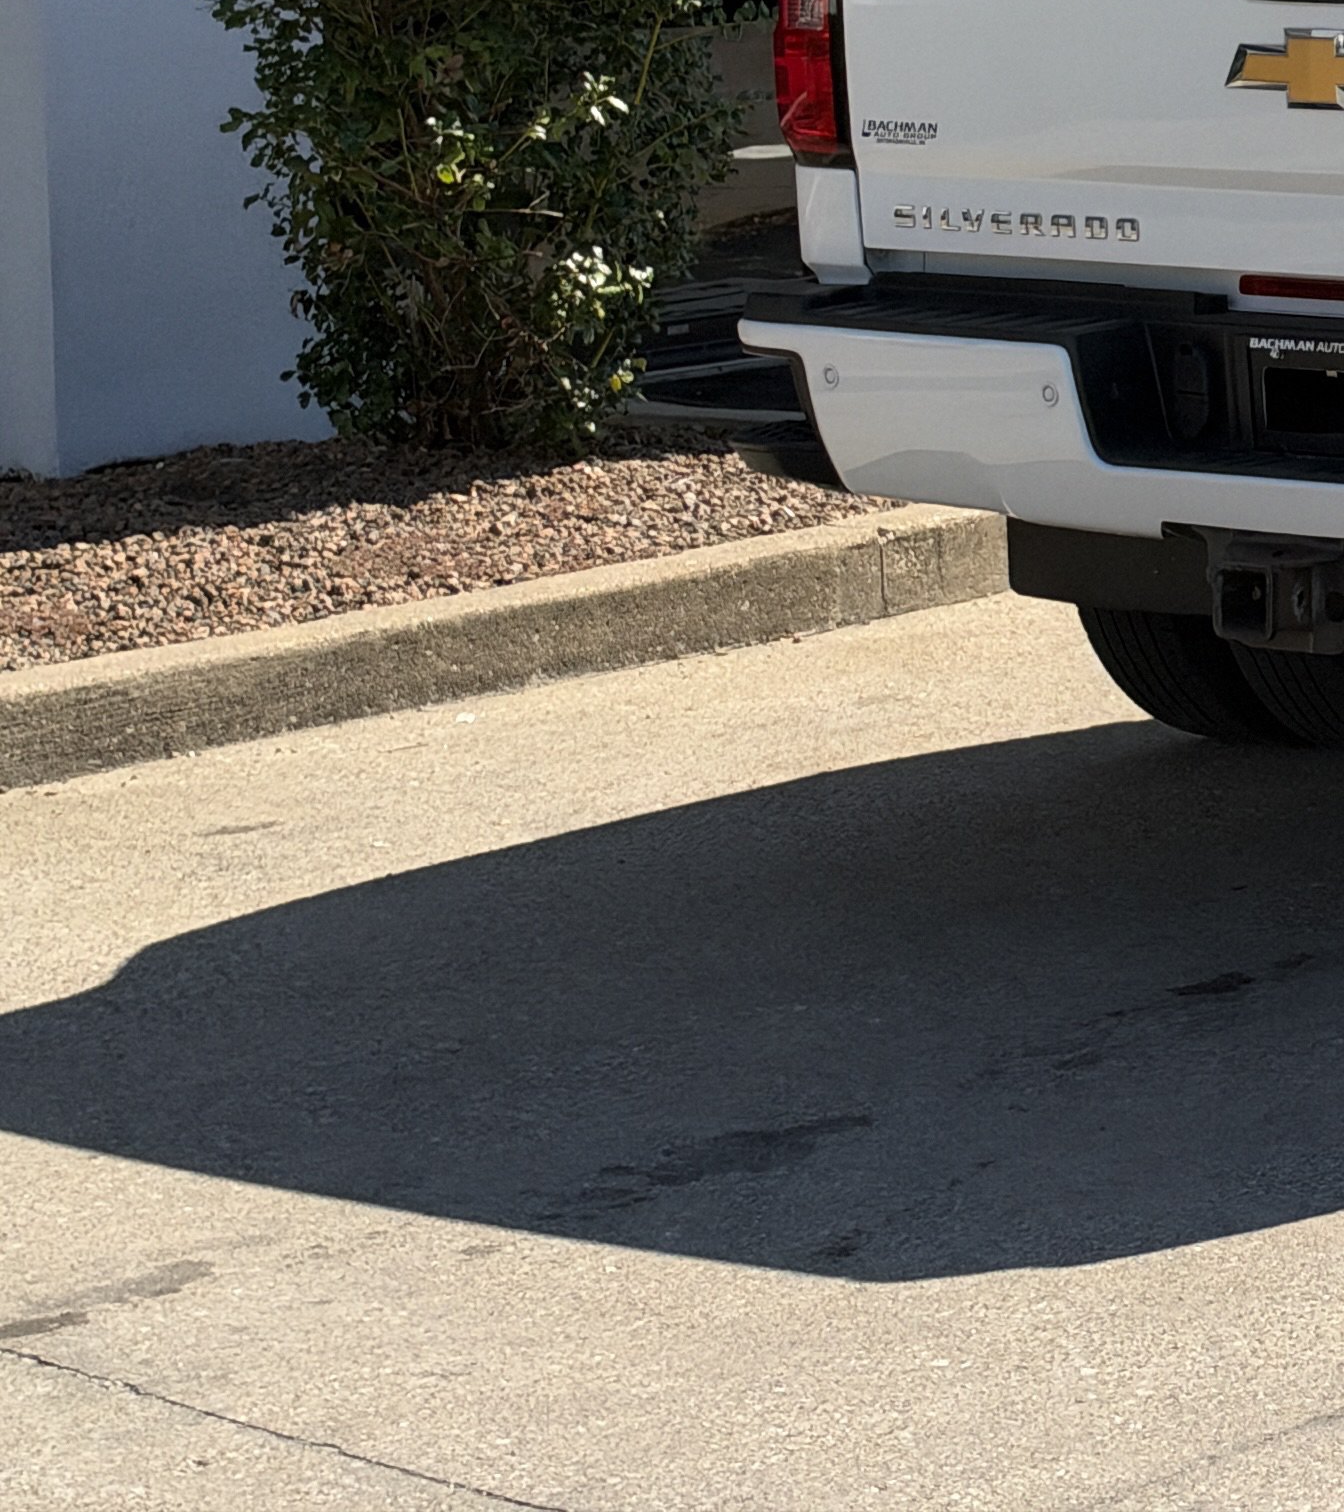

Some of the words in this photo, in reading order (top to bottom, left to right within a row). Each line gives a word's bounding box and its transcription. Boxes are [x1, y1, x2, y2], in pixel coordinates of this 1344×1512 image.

[867, 119, 938, 134] BACHMAN
[893, 205, 1141, 243] SILVERADO
[1249, 337, 1315, 352] BACHMAN
